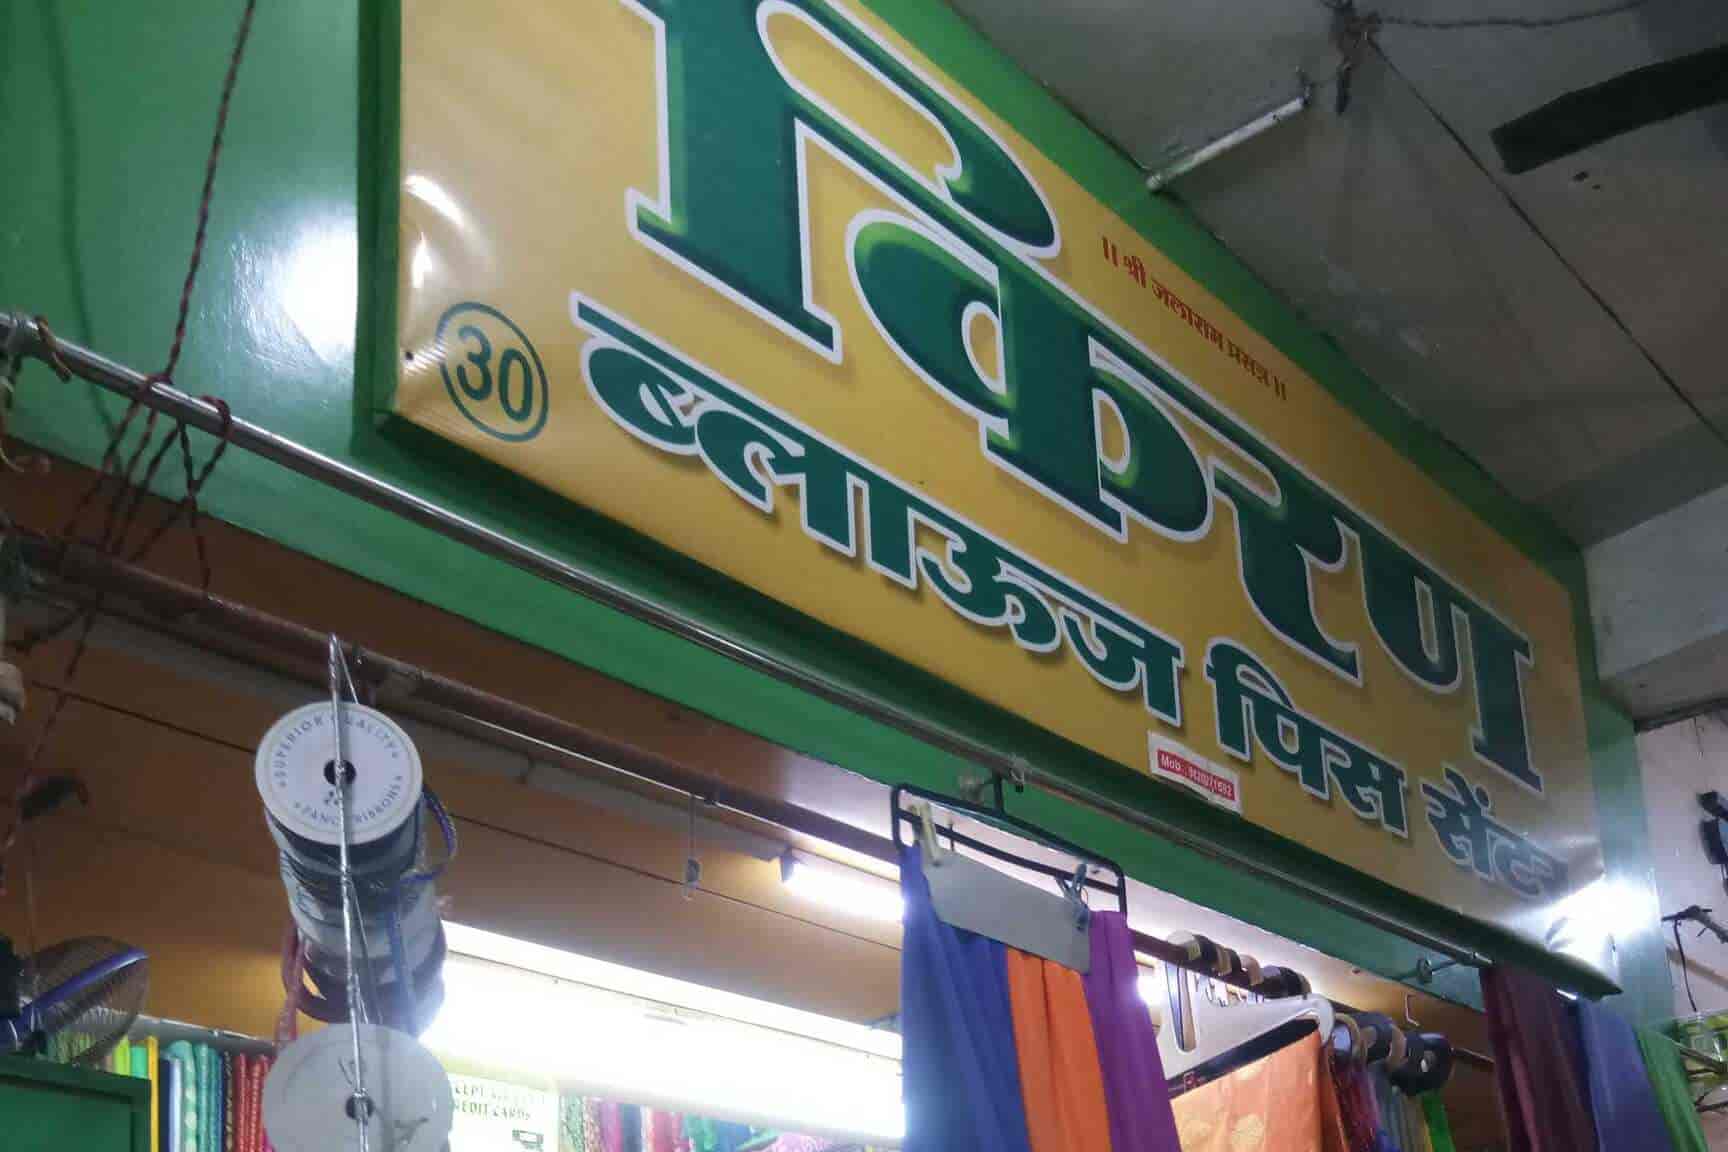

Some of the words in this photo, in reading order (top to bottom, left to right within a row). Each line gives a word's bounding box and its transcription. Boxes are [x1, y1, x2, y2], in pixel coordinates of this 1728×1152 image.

[456, 324, 533, 421] 30
[570, 290, 1183, 728] ब्लाऊज
[1204, 638, 1409, 839] पिस
[620, 0, 1542, 795] किरण
